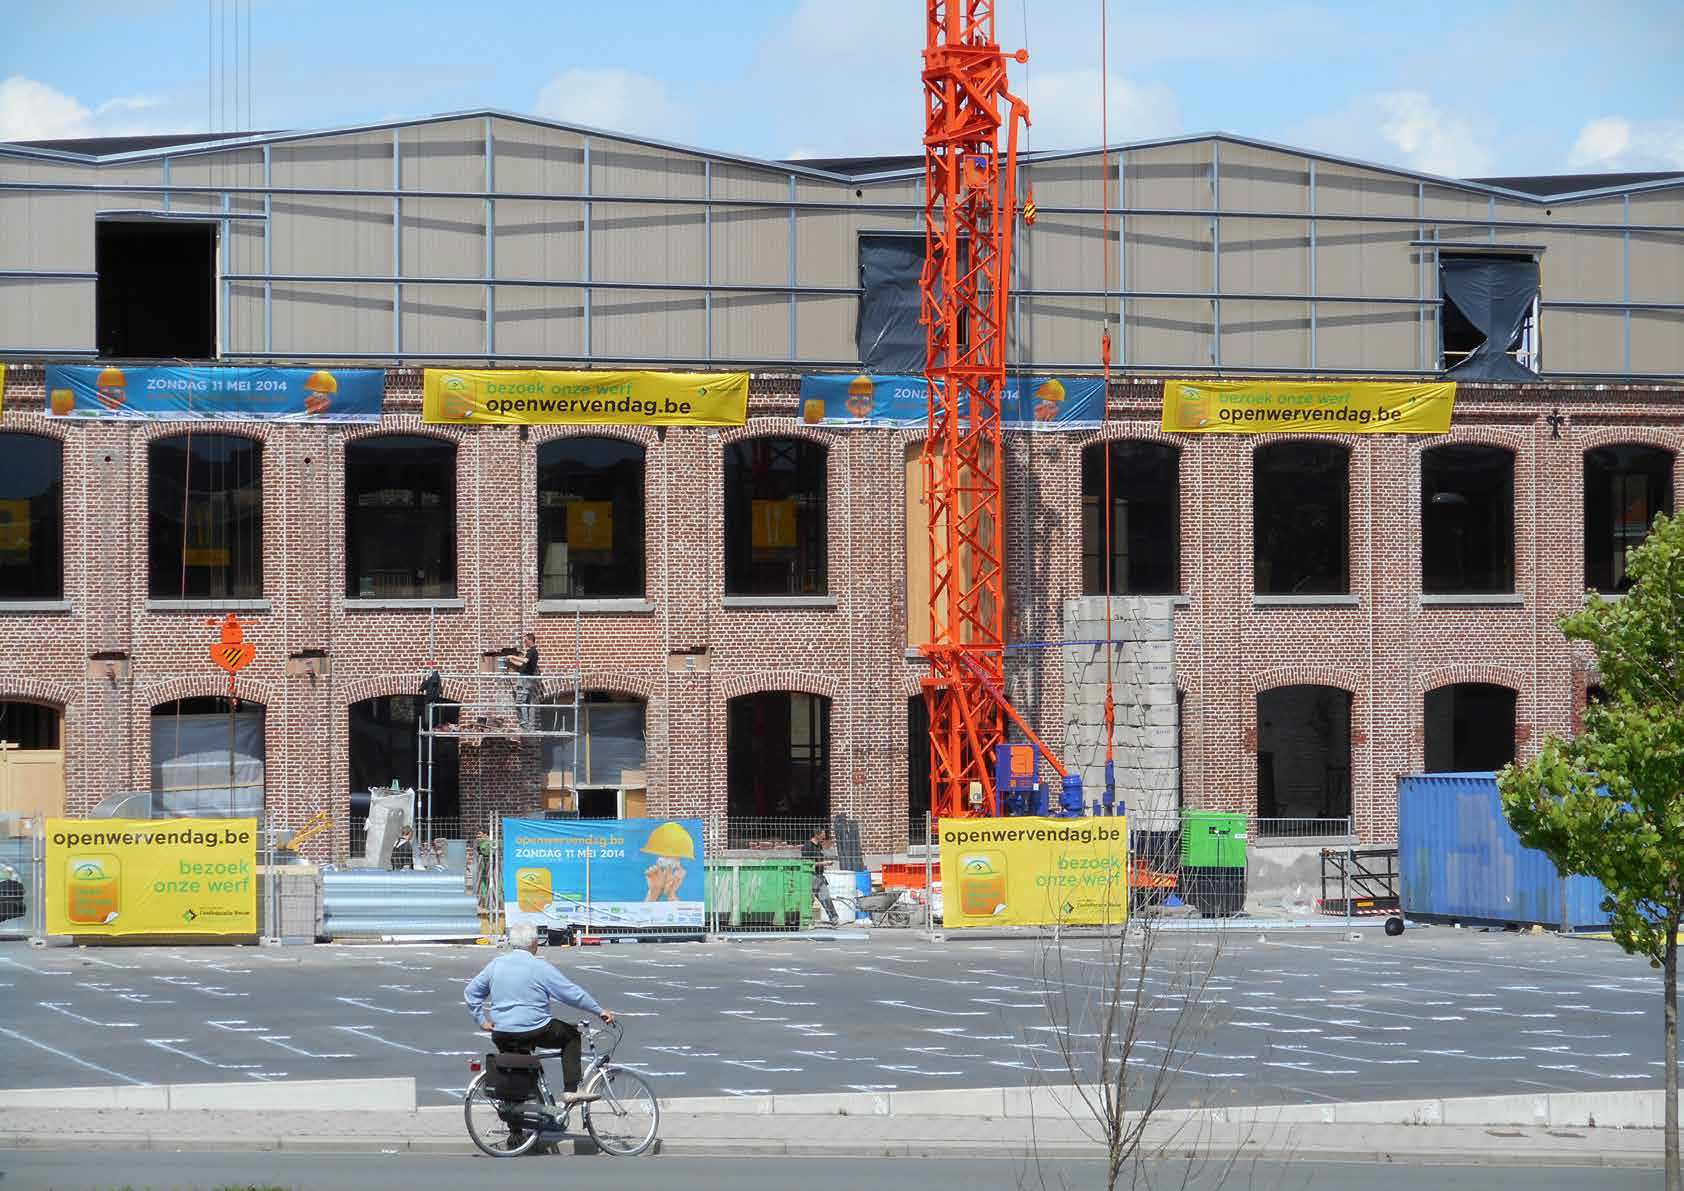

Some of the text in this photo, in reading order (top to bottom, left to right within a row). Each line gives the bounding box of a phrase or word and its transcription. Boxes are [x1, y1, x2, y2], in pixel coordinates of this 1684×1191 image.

[146, 379, 287, 391] ZONDAG 11 MEI 2014
[487, 382, 545, 395] bezoek
[551, 385, 592, 396] onze
[486, 397, 691, 415] openwervendag.be
[1279, 394, 1313, 405] onze
[1219, 406, 1402, 424] openwervendag.be
[53, 829, 250, 848] openwervendag.be
[945, 827, 1120, 845] openwervendag.be
[515, 848, 625, 858] ZONDAG 11 MEI 2014
[180, 860, 248, 875] bezoek
[1057, 856, 1120, 870] bezoek
[154, 878, 249, 893] onze werf
[1036, 873, 1121, 887] onze werf
